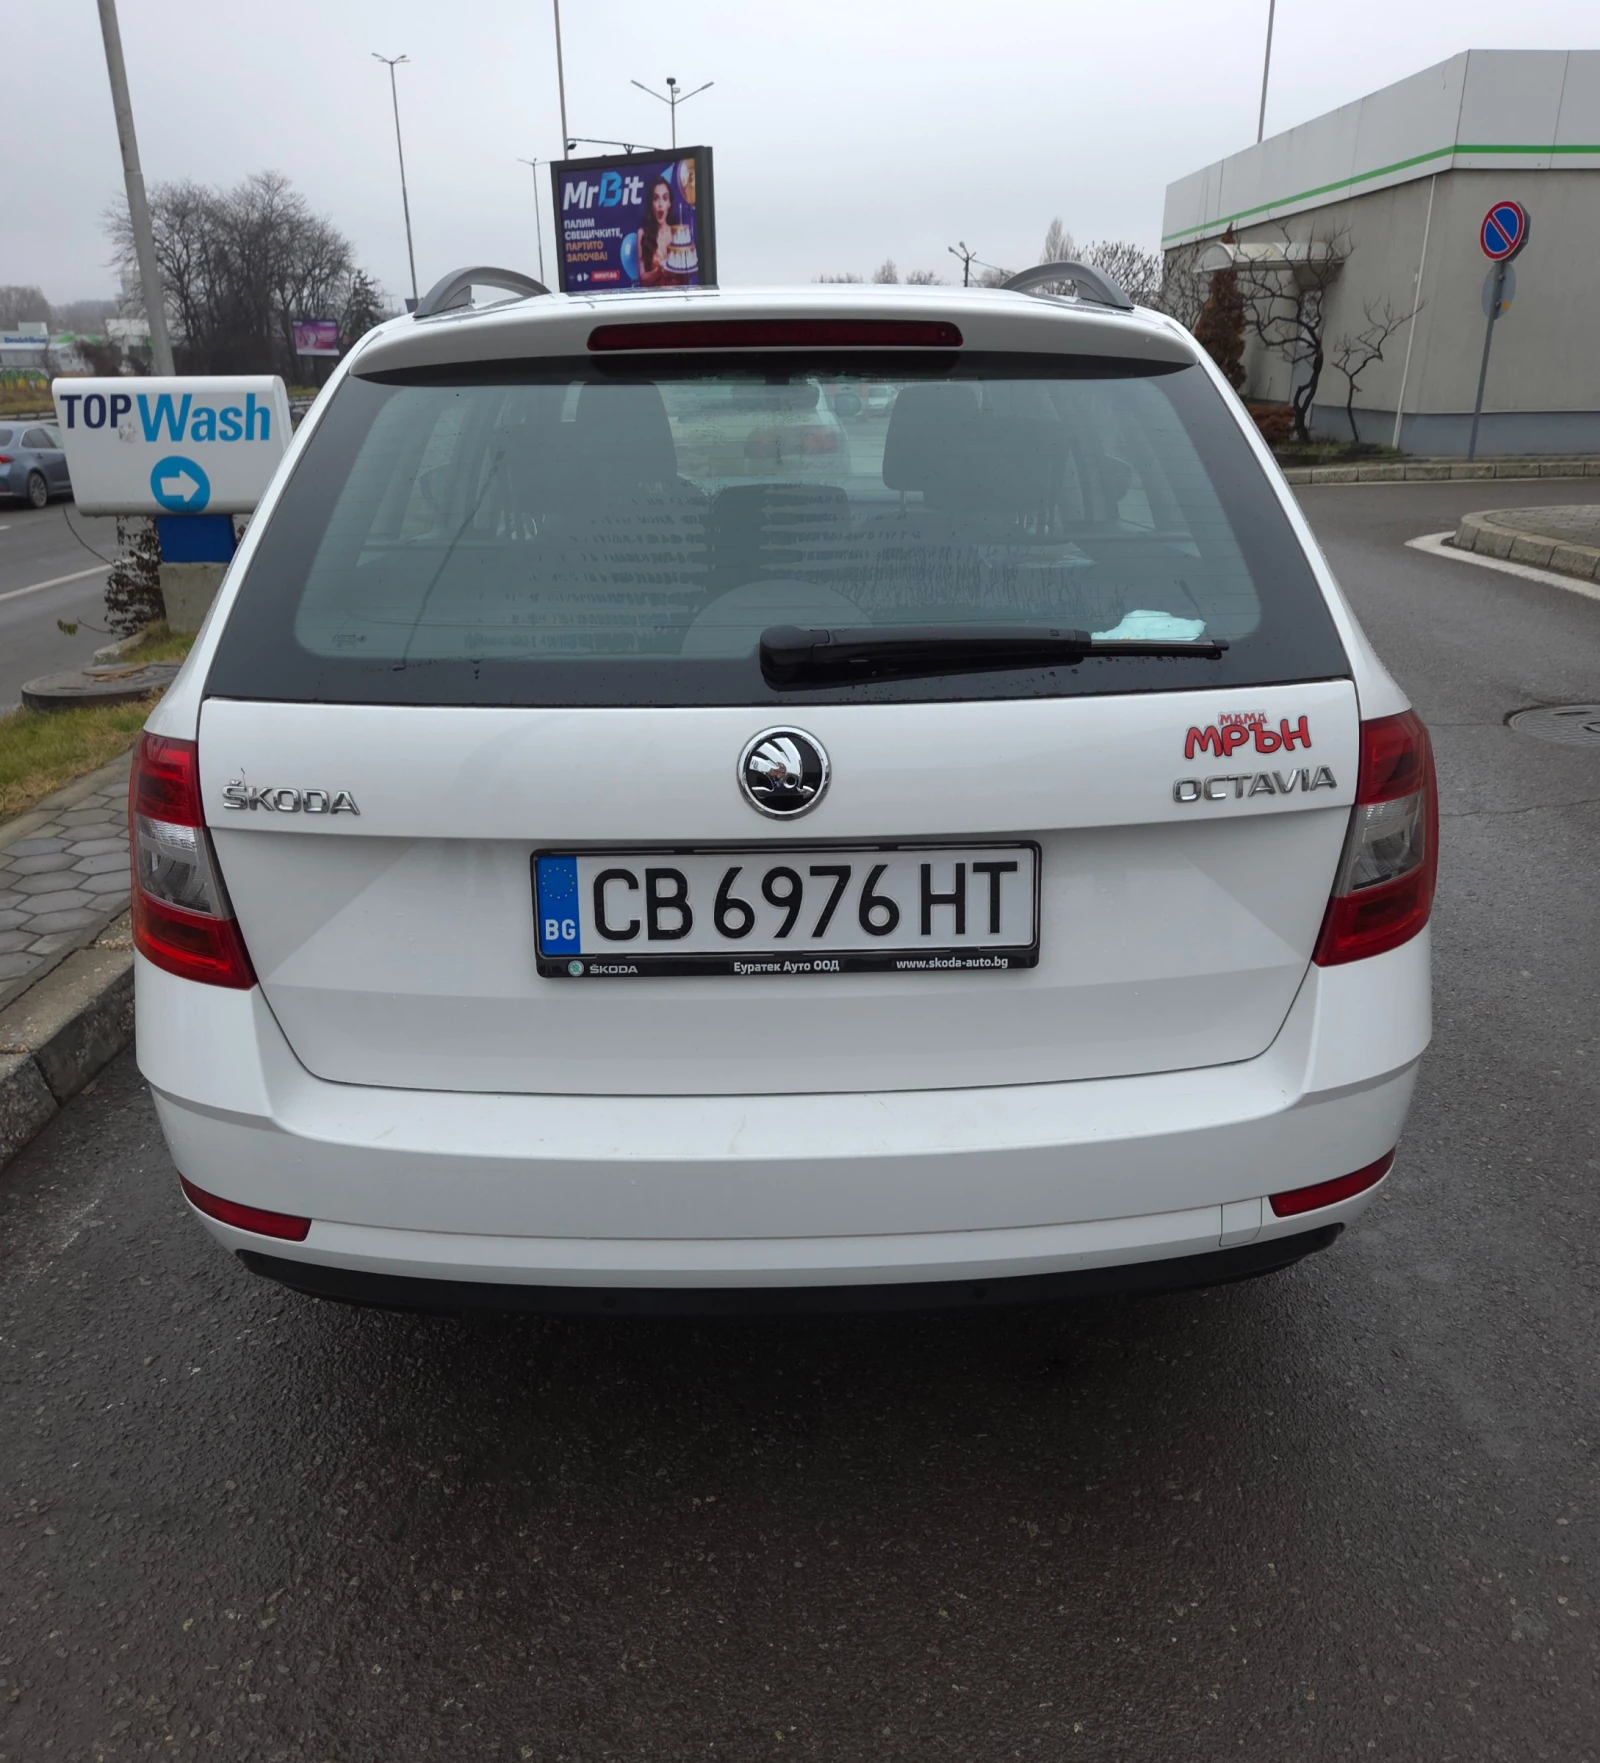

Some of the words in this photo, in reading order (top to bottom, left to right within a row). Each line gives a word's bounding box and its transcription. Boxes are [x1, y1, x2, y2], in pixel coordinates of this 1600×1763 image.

[563, 171, 644, 210] MrBit
[564, 218, 595, 229] ПАЛИМ
[564, 228, 623, 241] СВЕЩИЧКИТЕ,
[566, 241, 603, 252] ПАРТИТО
[567, 252, 608, 262] ЗАПОЧВА!
[60, 393, 132, 429] TOP
[136, 393, 271, 442] Wash
[1219, 712, 1268, 726] МАМА
[1184, 715, 1312, 760] МРЪН
[1173, 765, 1337, 803] OCTAVIA
[222, 779, 361, 816] ŠKODA
[713, 864, 900, 939] 6976
[545, 919, 576, 940] BG
[589, 963, 639, 974] ŠKODA
[733, 961, 781, 975] Еуратек
[783, 961, 811, 974] Ауто
[813, 959, 840, 972] ООД
[896, 955, 1009, 968] www.skoda-auto.bg
